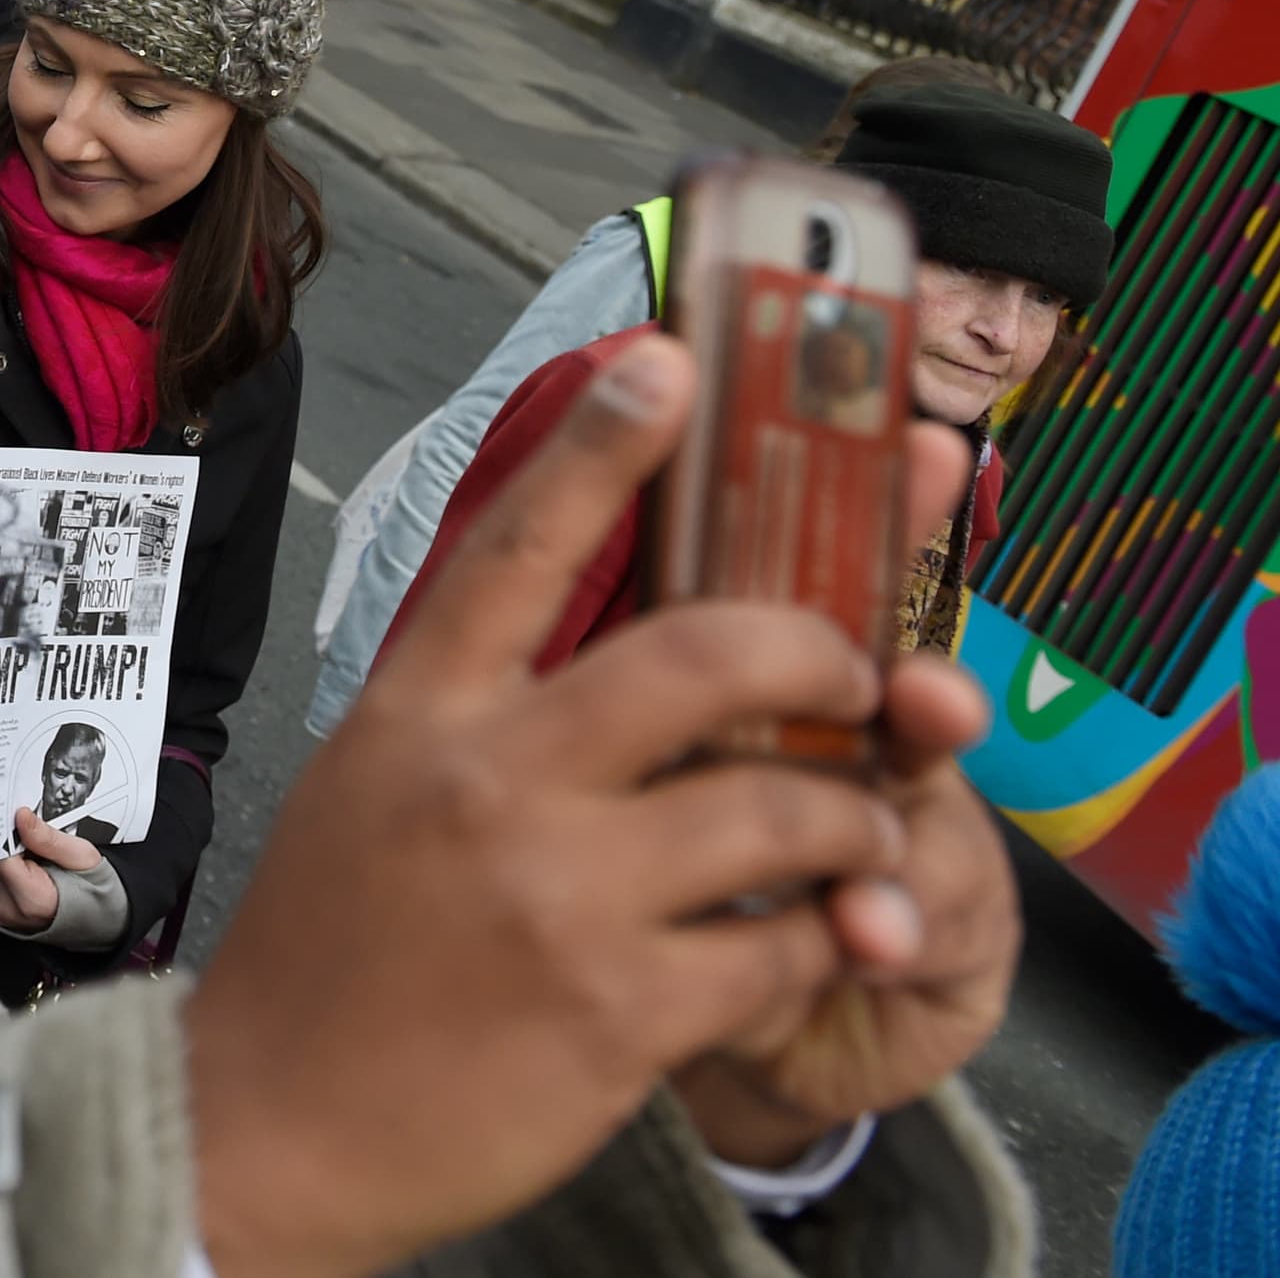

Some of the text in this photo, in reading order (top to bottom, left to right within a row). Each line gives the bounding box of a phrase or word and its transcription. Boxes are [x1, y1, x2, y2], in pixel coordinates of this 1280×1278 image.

[88, 531, 139, 558] NOT
[97, 559, 116, 577] MY
[79, 577, 134, 610] PRESIDENT
[35, 643, 149, 702] TRUMP!
